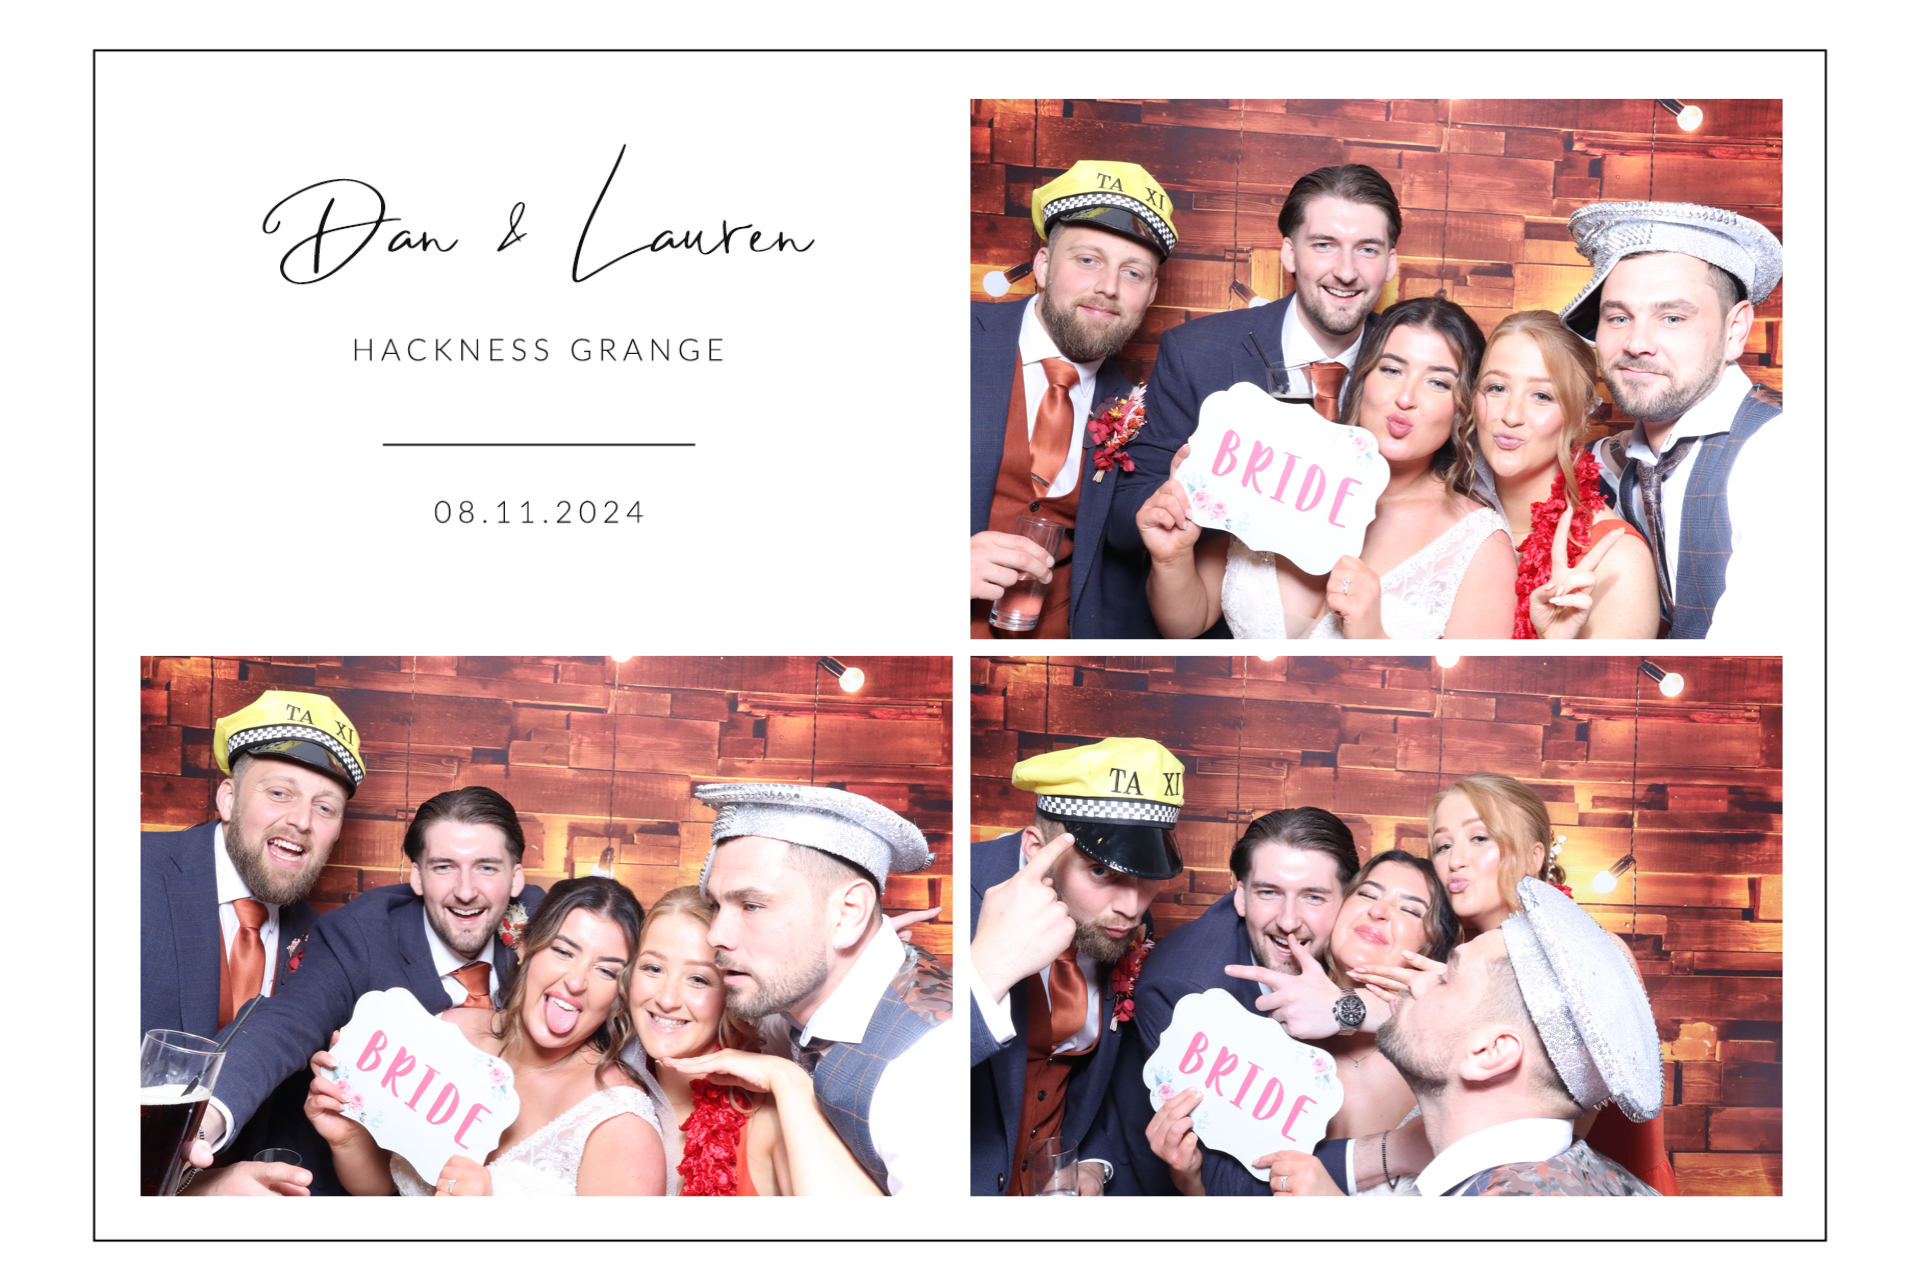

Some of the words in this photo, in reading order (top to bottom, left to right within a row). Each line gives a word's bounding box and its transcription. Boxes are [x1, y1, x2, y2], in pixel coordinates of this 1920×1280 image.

[1211, 429, 1363, 528] BRIDE
[356, 1029, 492, 1150] BRIDE
[1178, 1031, 1318, 1142] BRIDE
